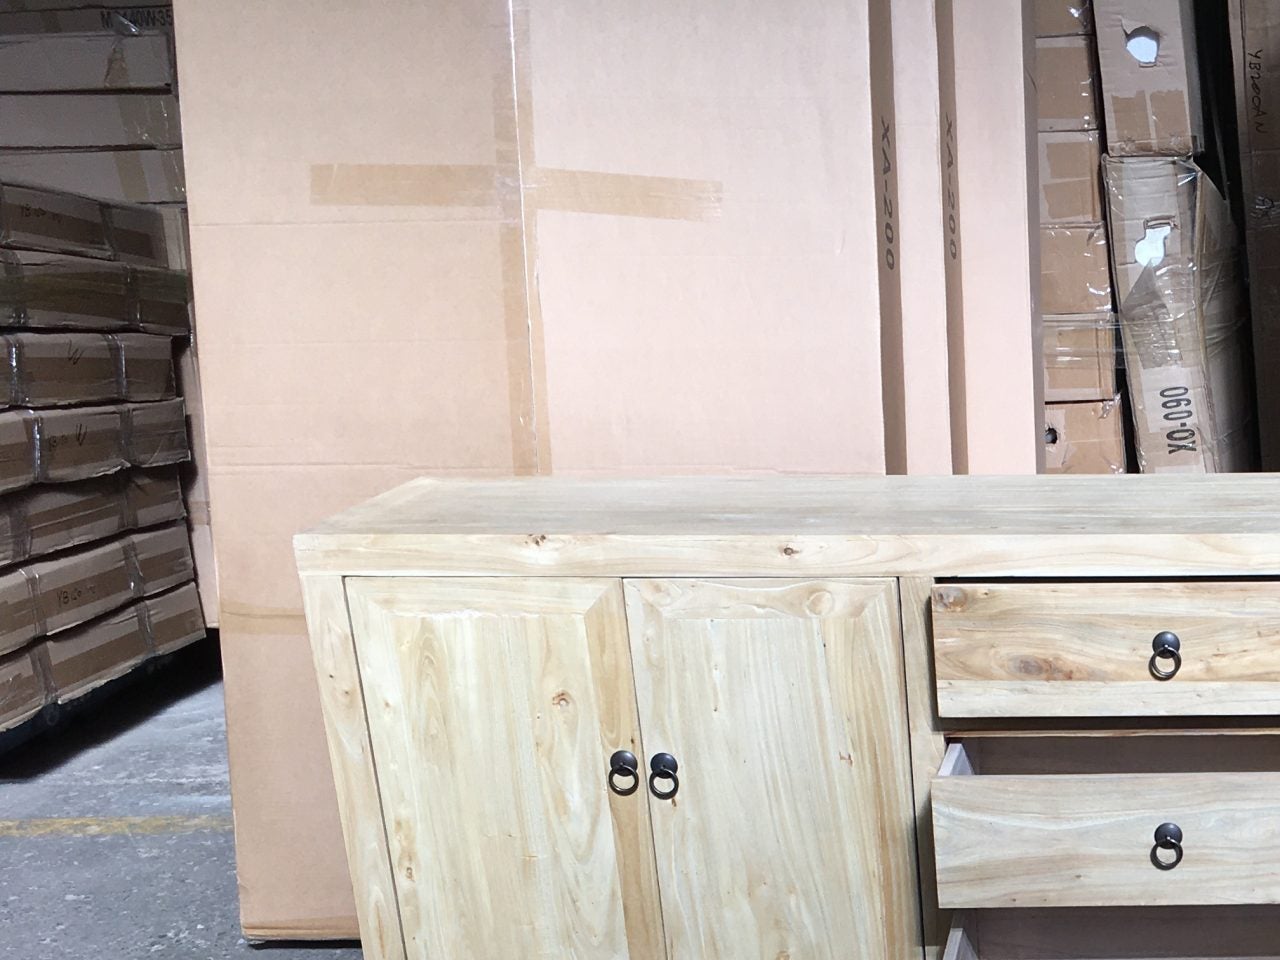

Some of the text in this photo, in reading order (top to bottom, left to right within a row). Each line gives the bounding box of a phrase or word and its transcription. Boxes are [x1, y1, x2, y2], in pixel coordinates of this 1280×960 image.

[881, 115, 895, 270] XA-200
[945, 112, 957, 260] XA-200
[1160, 386, 1197, 455] XO-090
